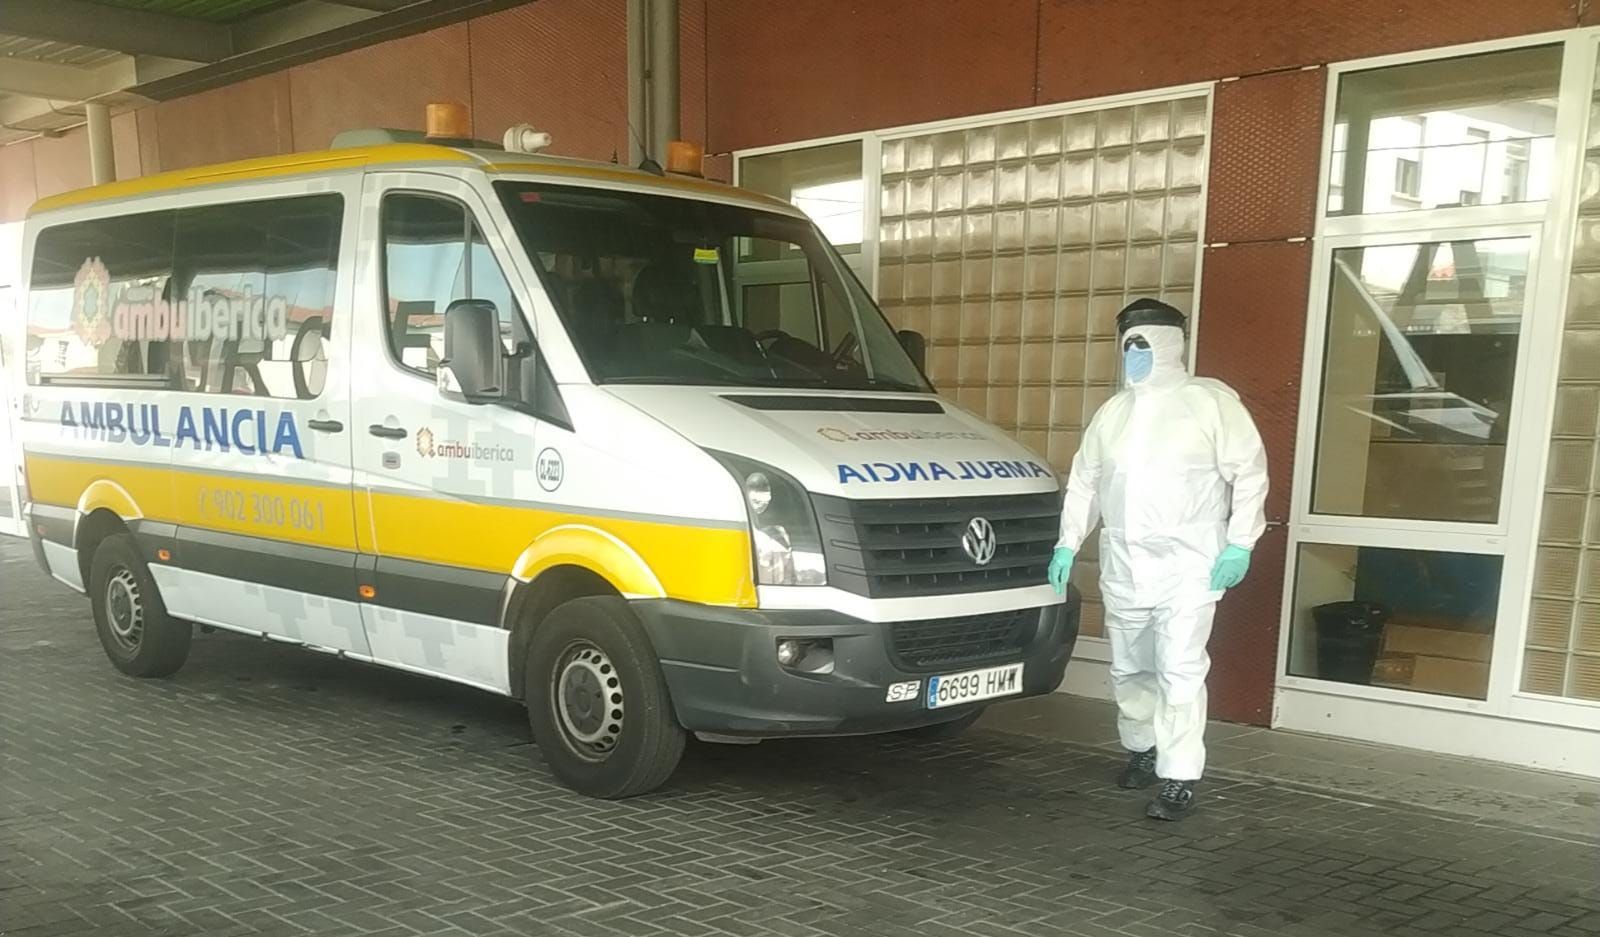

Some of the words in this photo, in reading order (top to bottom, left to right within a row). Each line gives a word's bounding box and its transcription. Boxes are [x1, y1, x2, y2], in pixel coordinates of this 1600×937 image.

[114, 285, 288, 342] ambuiberica
[60, 400, 305, 460] AMBULANCIA
[437, 441, 514, 462] ambuiberica
[213, 487, 247, 521] 902
[252, 491, 285, 526] 300
[289, 496, 325, 533] 061
[891, 683, 918, 700] SP
[939, 673, 980, 702] 6699
